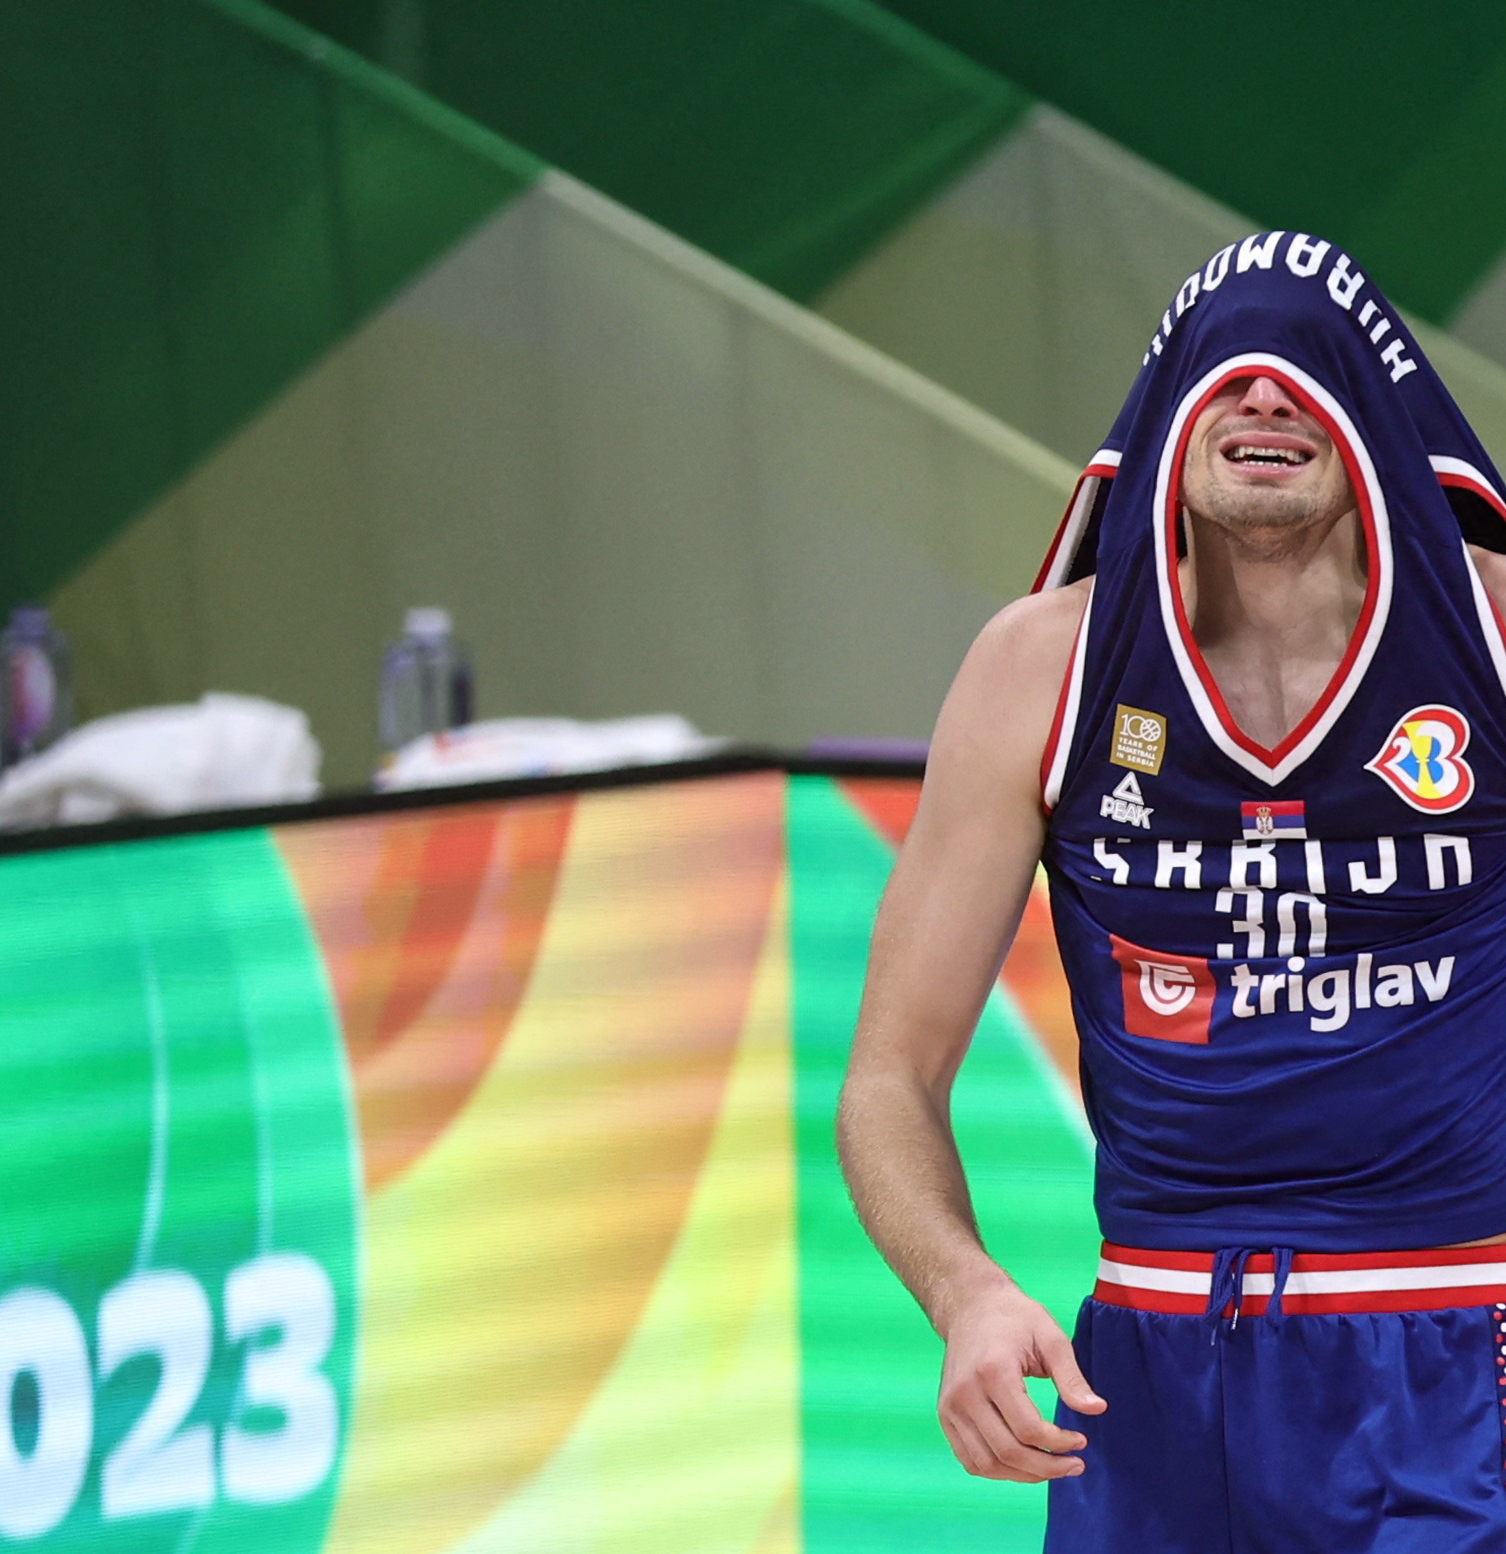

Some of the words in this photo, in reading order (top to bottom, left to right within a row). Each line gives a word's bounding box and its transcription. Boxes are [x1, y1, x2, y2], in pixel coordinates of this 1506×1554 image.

[1117, 744, 1157, 760] BASKETBALL
[1118, 737, 1143, 748] YEARS
[1147, 744, 1159, 752] OF
[1127, 755, 1155, 767] SERBIA
[1100, 794, 1154, 829] PEAK
[1231, 953, 1456, 1032] triglav
